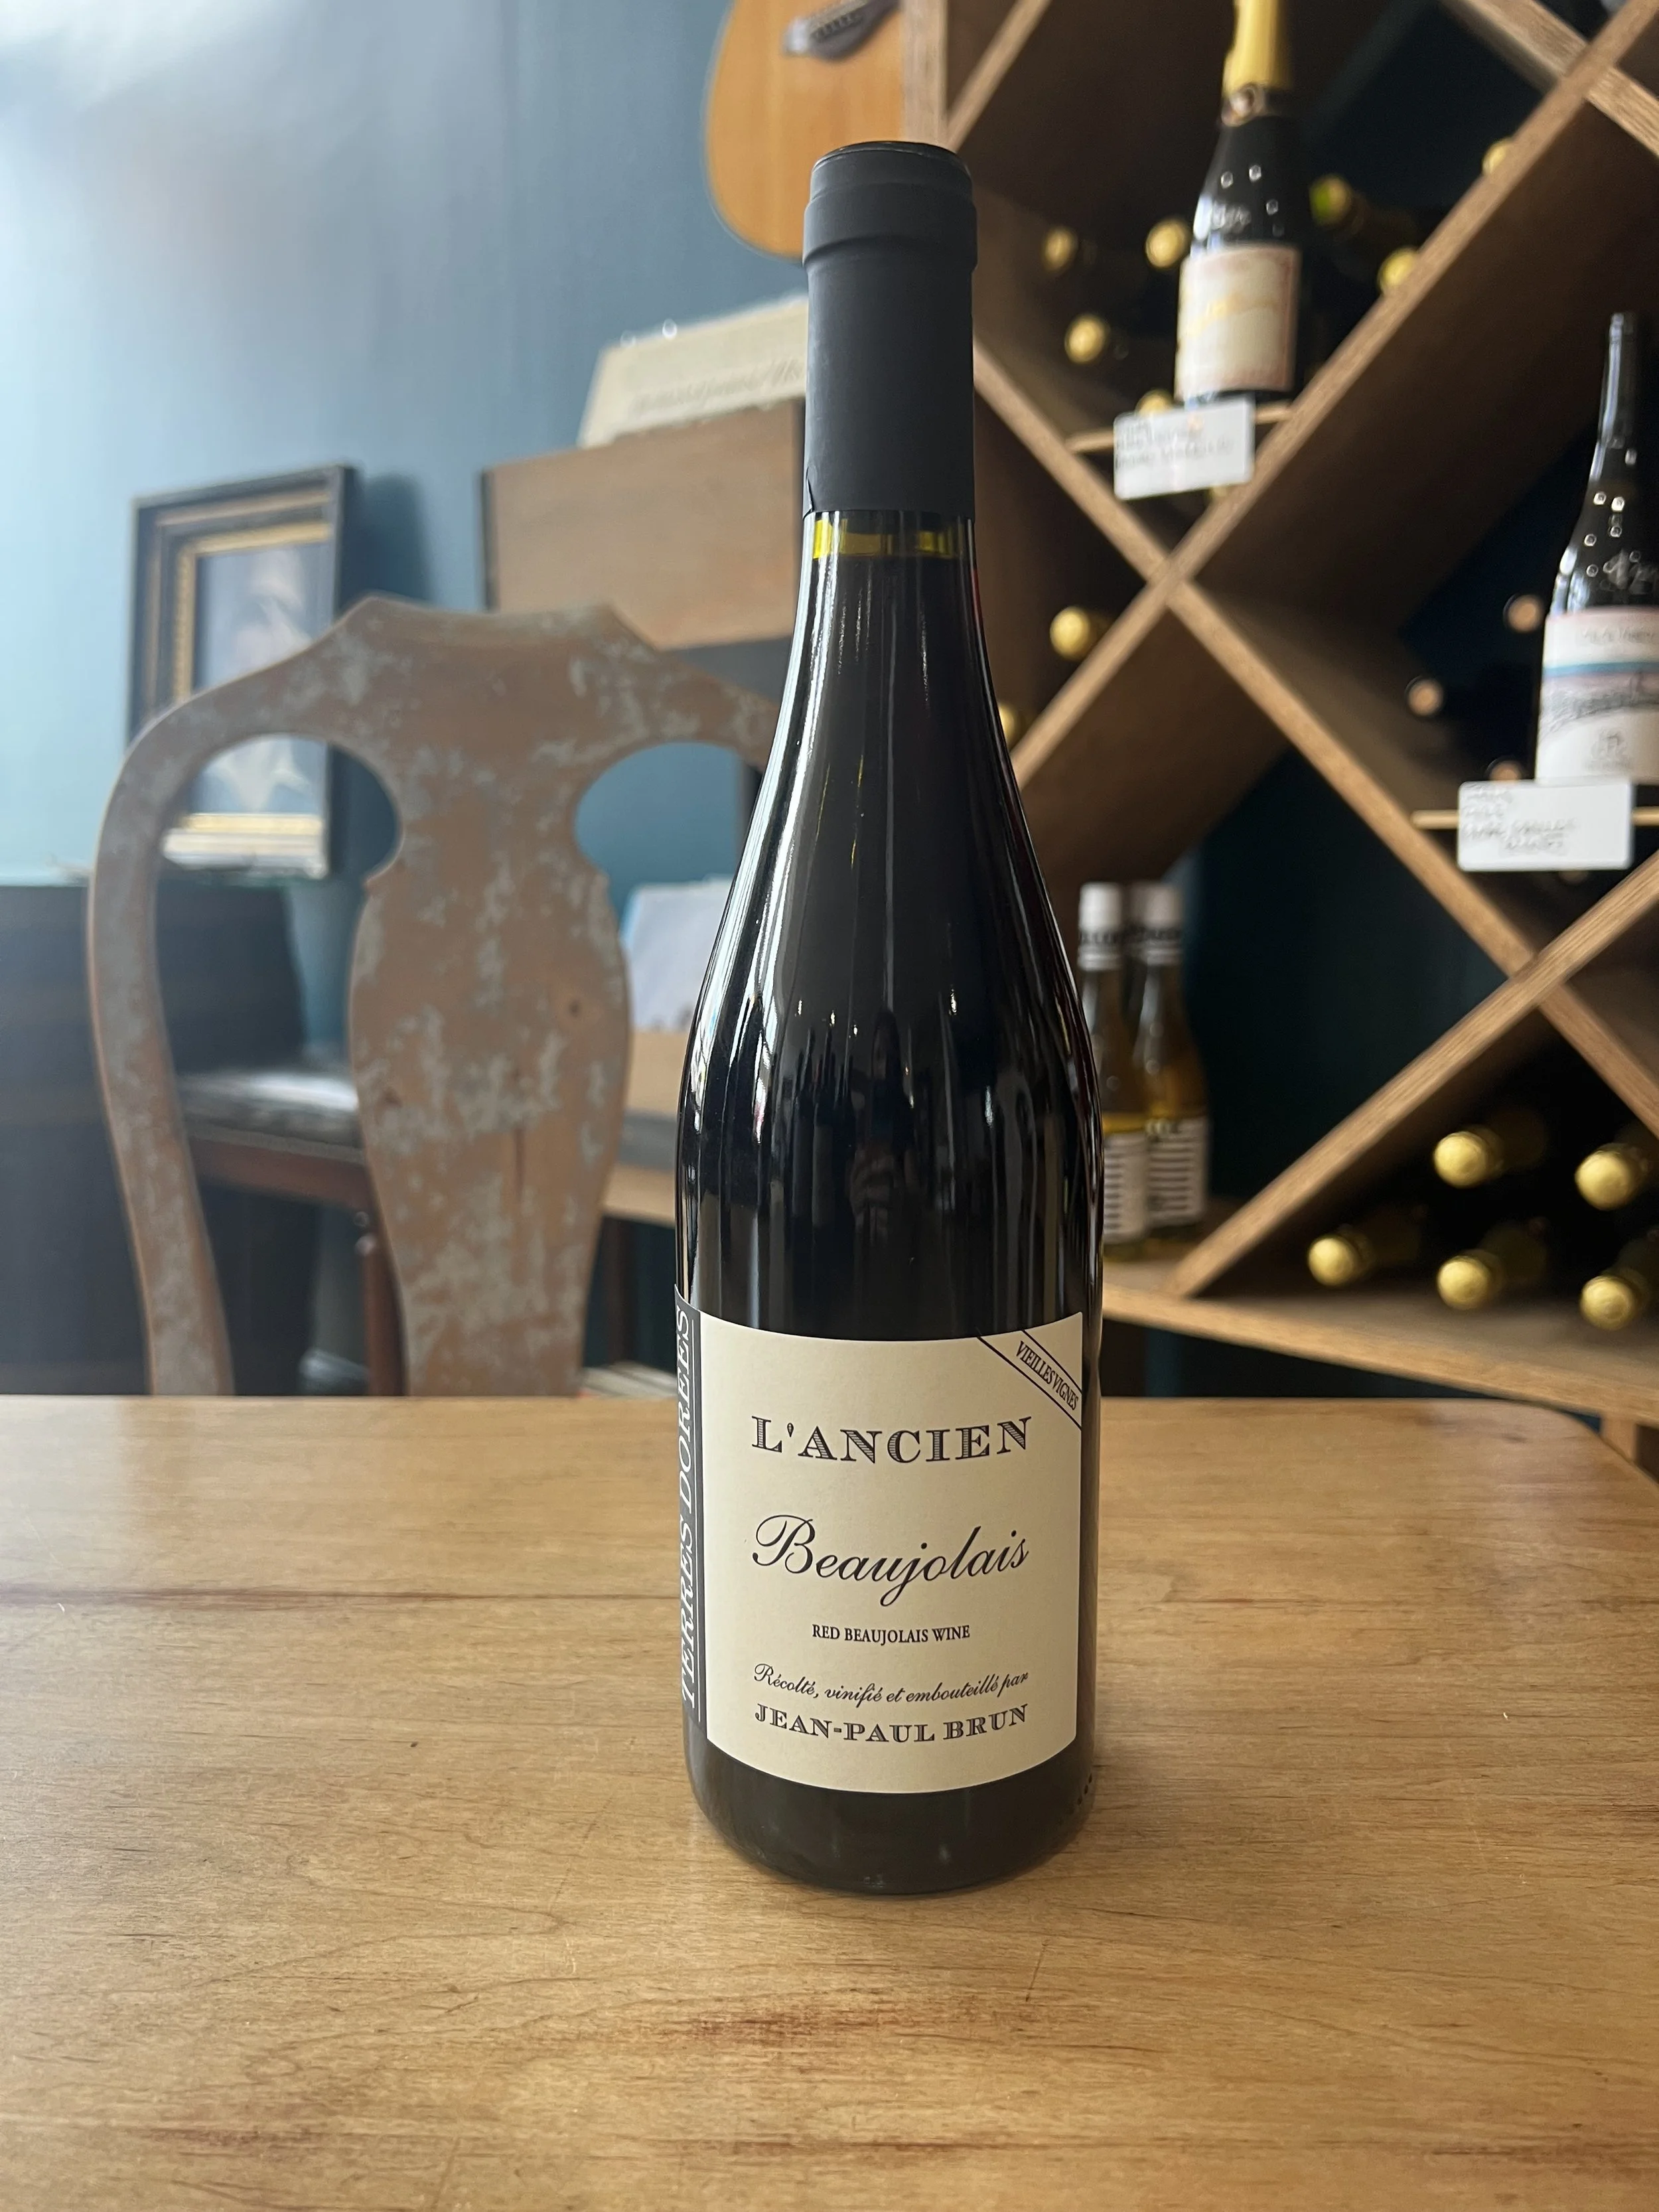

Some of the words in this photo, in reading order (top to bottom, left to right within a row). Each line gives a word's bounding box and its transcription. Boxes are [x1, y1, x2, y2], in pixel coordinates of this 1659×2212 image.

[1016, 1340, 1056, 1384] VIEILLES
[1052, 1373, 1079, 1410] VIGNES
[751, 1415, 1032, 1464] L'ANCIEN
[752, 1514, 1029, 1607] Beaujolais
[680, 1514, 695, 1709] TERRES
[812, 1623, 840, 1639] RED
[844, 1627, 928, 1646] BEAUJOLAIS
[932, 1625, 970, 1642] WINE
[754, 1663, 819, 1699] Récolté,
[824, 1682, 883, 1708] vinifié
[886, 1688, 906, 1702] et
[906, 1673, 999, 1702] embouteillé
[997, 1672, 1029, 1698] par
[755, 1703, 935, 1743] JEAN-PAUL
[942, 1703, 1029, 1740] BRUN
